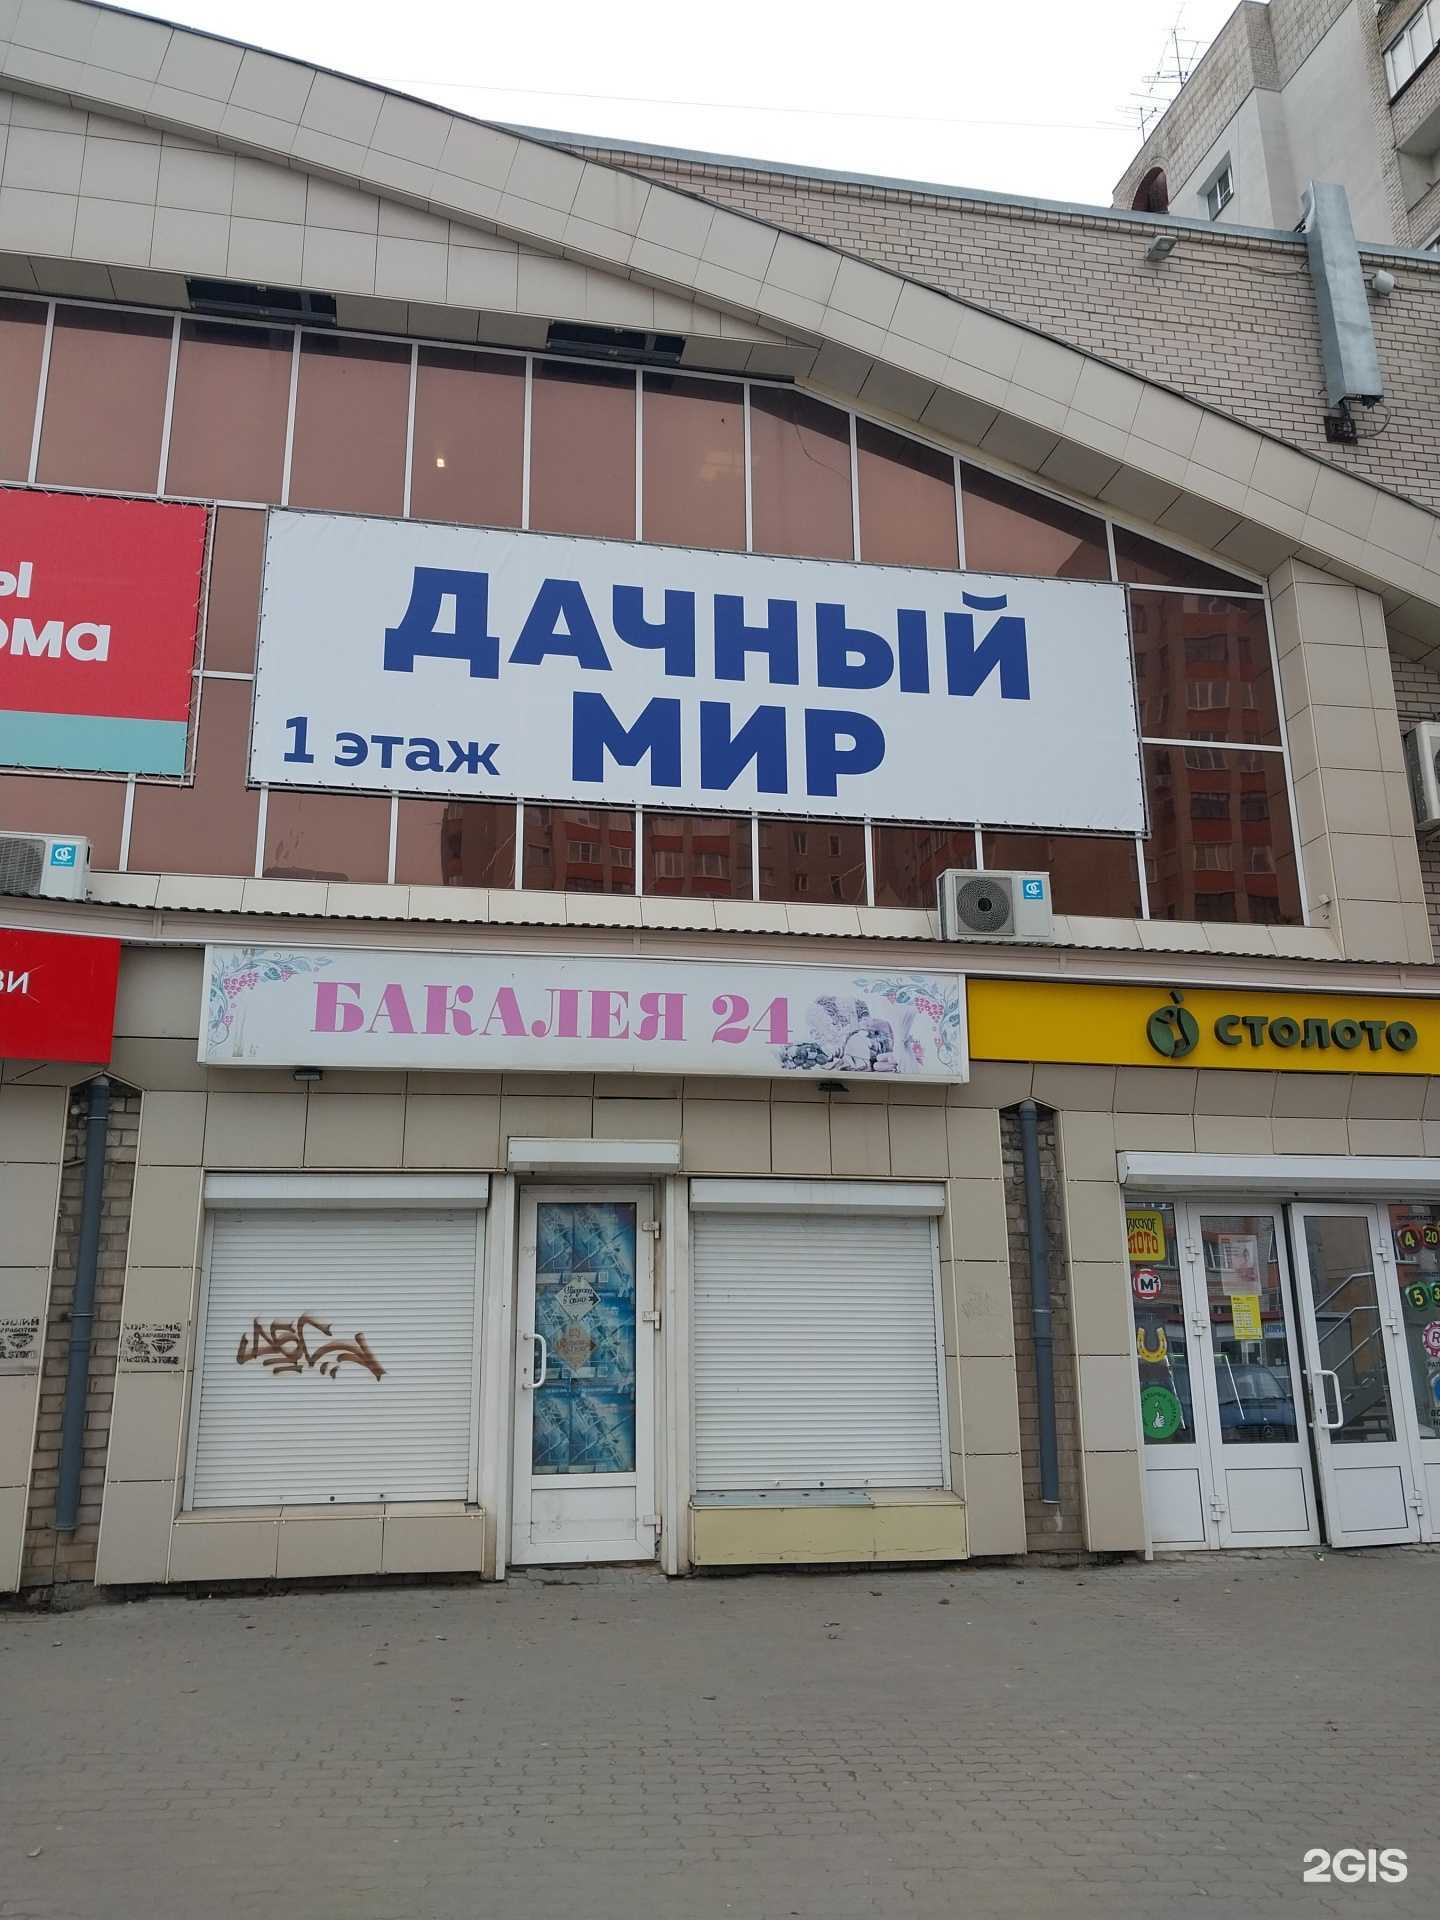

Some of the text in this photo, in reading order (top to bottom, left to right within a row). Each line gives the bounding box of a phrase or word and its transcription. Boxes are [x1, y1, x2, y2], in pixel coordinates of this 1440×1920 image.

[0, 617, 111, 662] ма
[383, 566, 1031, 701] ДАЧНЫЙ
[283, 716, 501, 776] 1 этаж
[572, 690, 886, 797] МИР
[310, 981, 794, 1045] БАКАЛЕЯ 24
